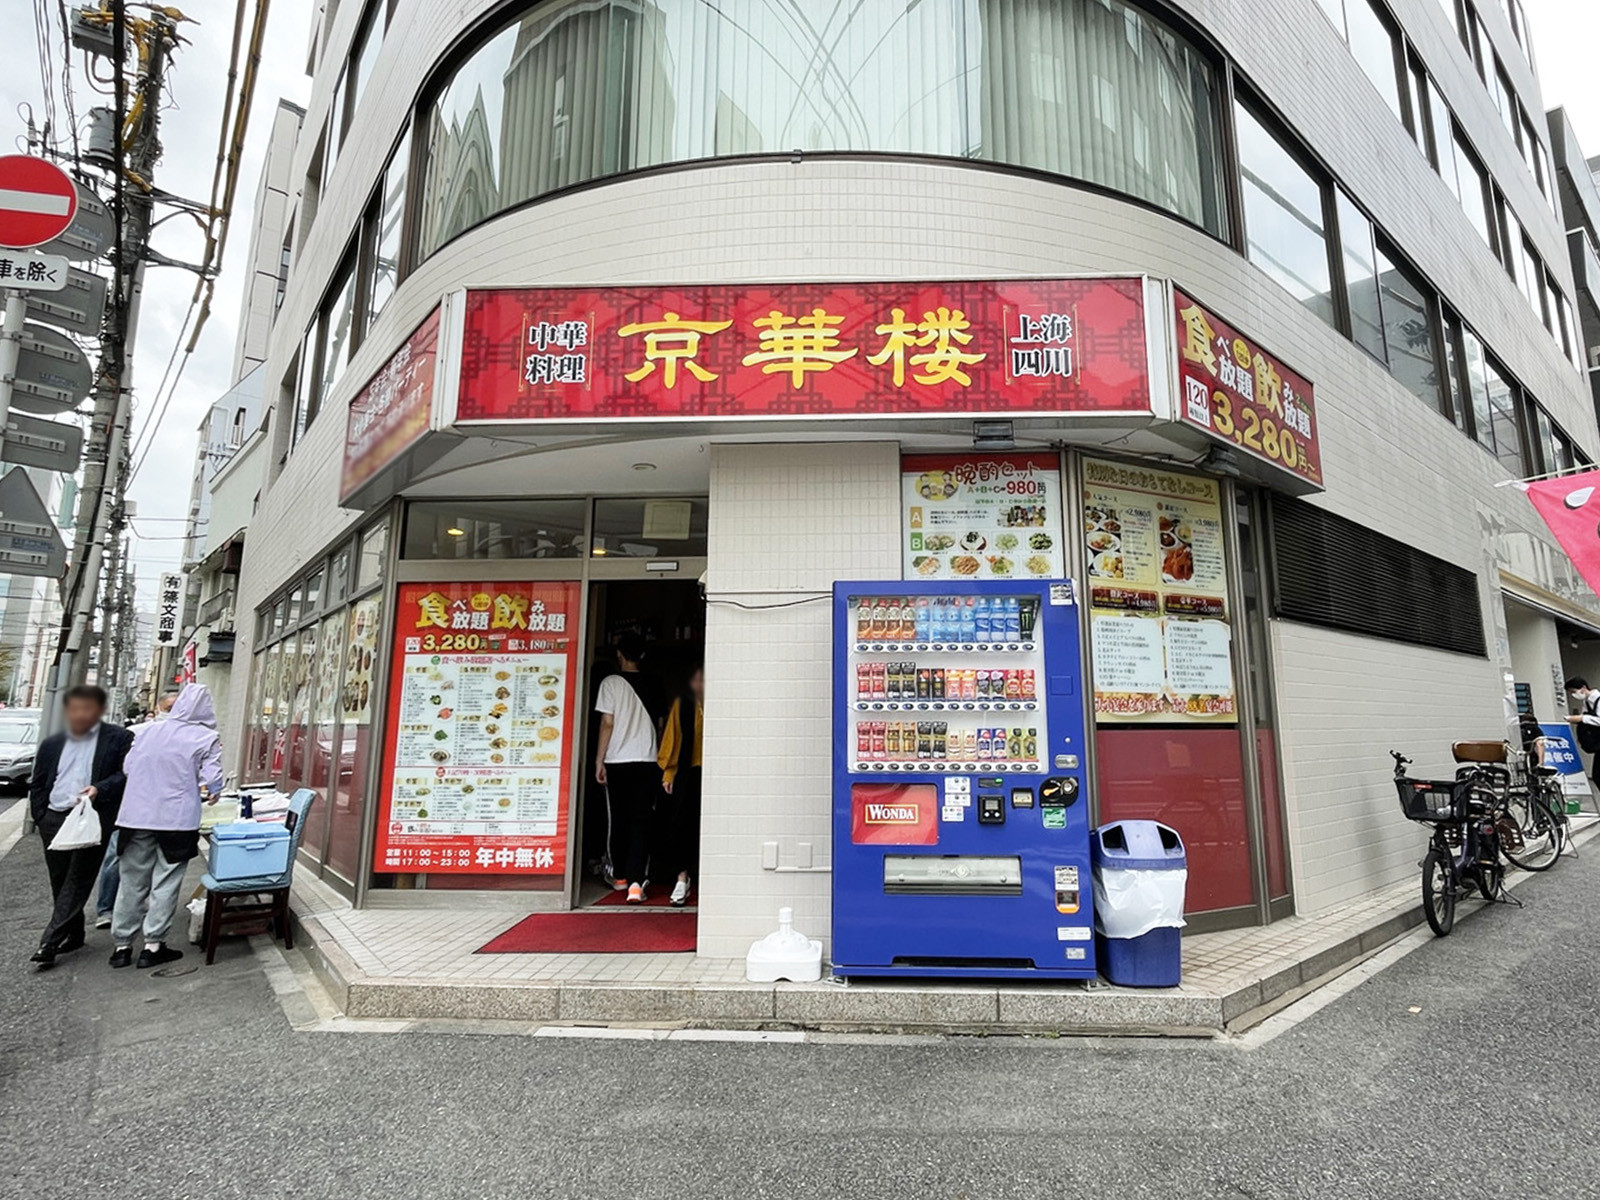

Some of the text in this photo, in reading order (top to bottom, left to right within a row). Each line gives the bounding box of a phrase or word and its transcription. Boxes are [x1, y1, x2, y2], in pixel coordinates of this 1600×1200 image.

[529, 322, 587, 352] 中華
[1010, 314, 1072, 344] 上海
[617, 307, 987, 389] 京華楼
[1010, 347, 1073, 378] 四川
[525, 355, 586, 384] 料理
[1188, 381, 1208, 410] 120
[955, 461, 1041, 486] 晩酌セット
[912, 537, 921, 549] B
[475, 847, 554, 868] 年中無休
